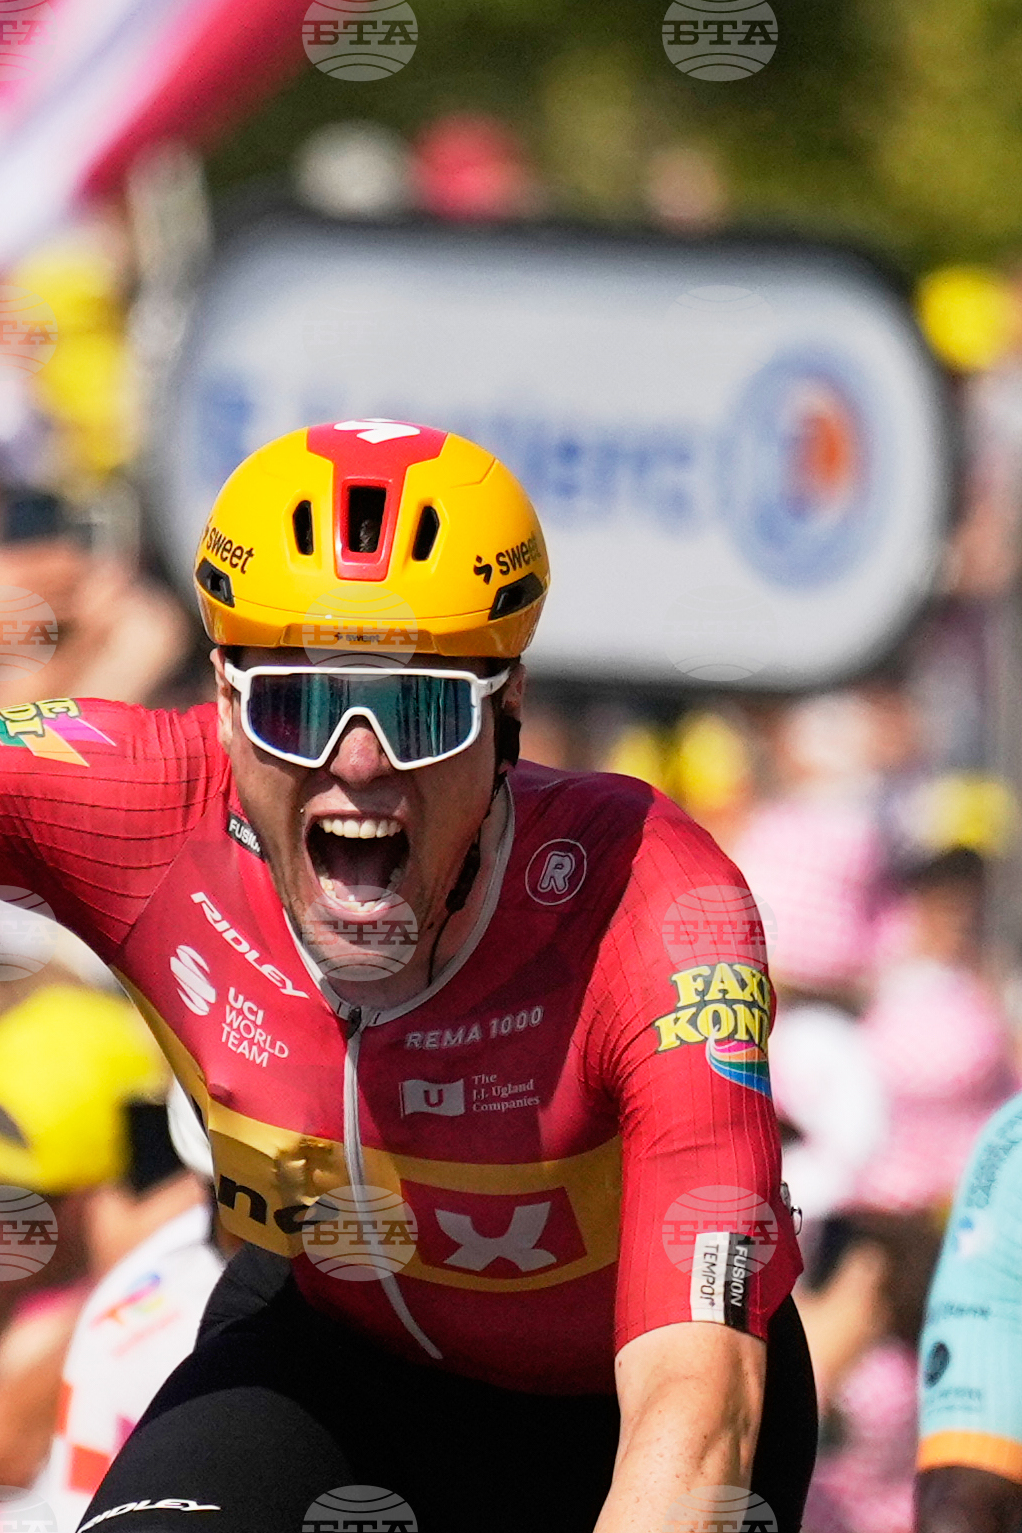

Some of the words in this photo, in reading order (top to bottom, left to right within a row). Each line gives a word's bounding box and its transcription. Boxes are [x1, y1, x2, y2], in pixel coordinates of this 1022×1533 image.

[206, 527, 255, 574] sweet
[538, 851, 575, 894] R
[190, 891, 310, 999] RIDLEY
[227, 986, 265, 1026] UCI
[670, 962, 771, 1010] FAX
[221, 1022, 269, 1068] TEAM
[225, 1004, 289, 1059] WORLD
[405, 1023, 482, 1049] REMA
[489, 1005, 545, 1039] 1000
[655, 1003, 769, 1053] KON
[423, 1088, 444, 1108] U
[472, 1073, 497, 1085] The
[491, 1078, 534, 1098] Ugland
[472, 1095, 540, 1112] Companies
[730, 1245, 748, 1307] FUSION
